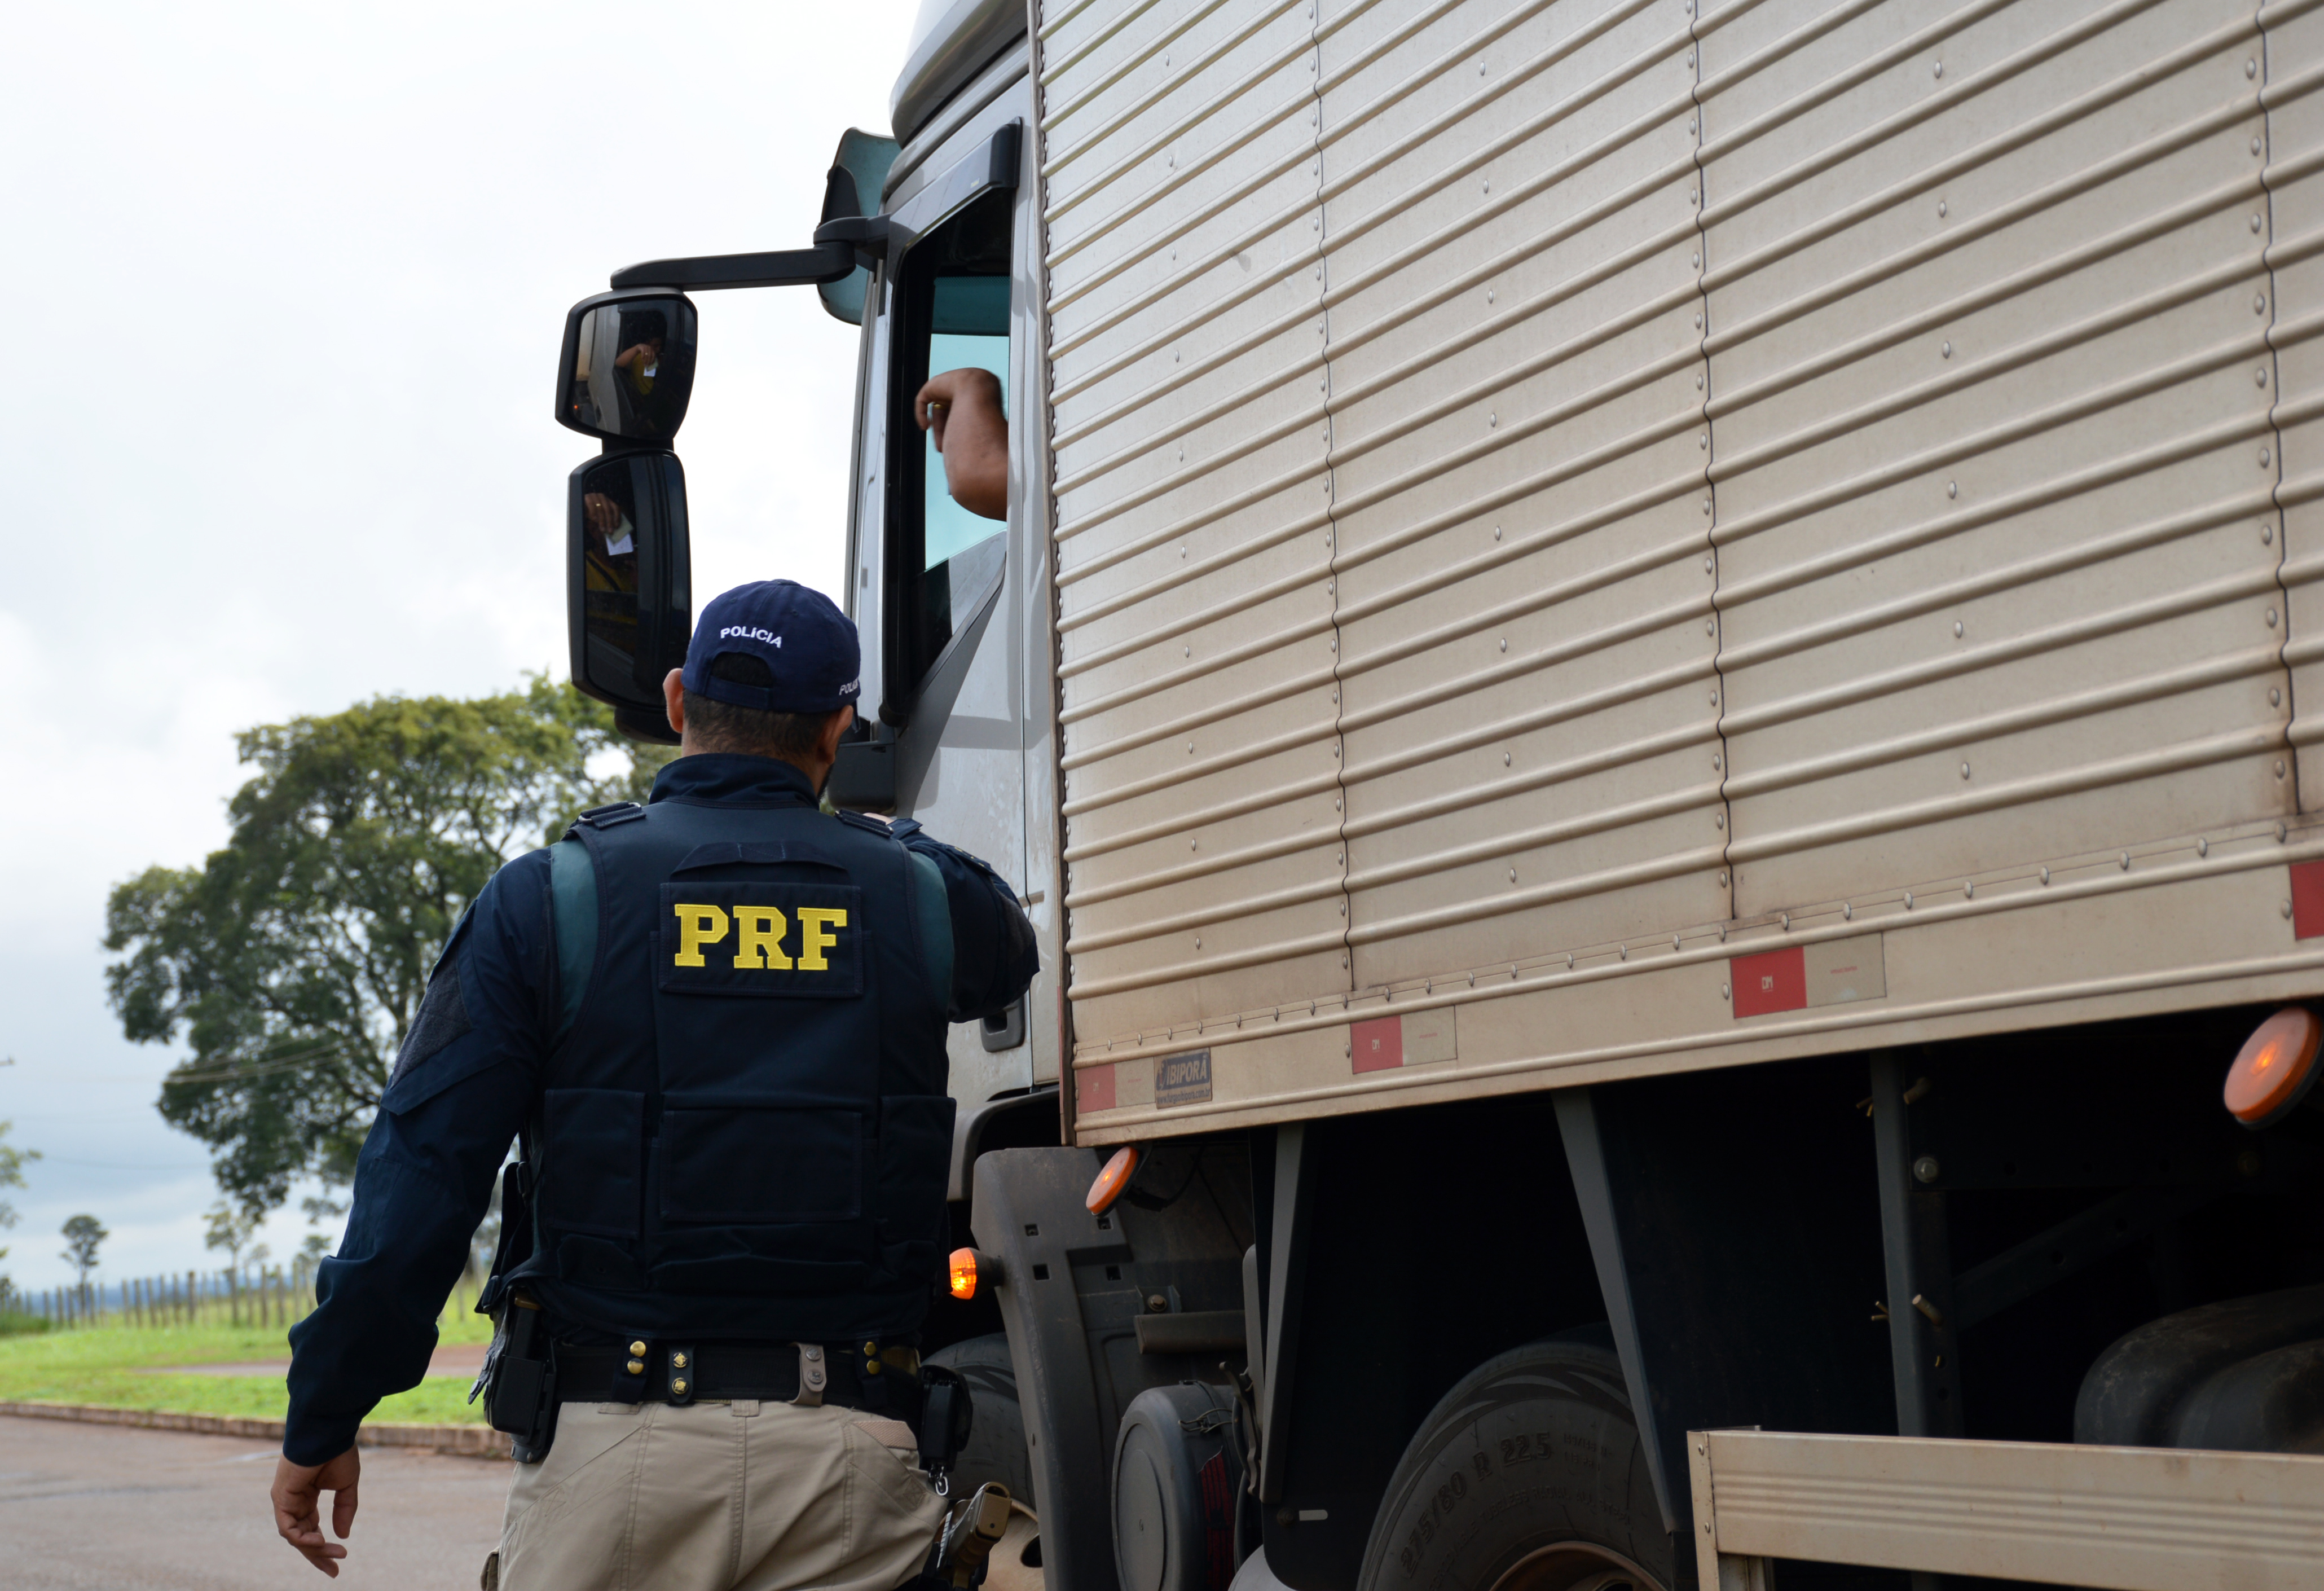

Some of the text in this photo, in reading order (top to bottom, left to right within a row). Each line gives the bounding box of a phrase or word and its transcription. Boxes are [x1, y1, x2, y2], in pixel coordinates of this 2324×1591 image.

[674, 904, 847, 970] PRF
[1399, 1431, 1552, 1579] 275/80 R 22.5
